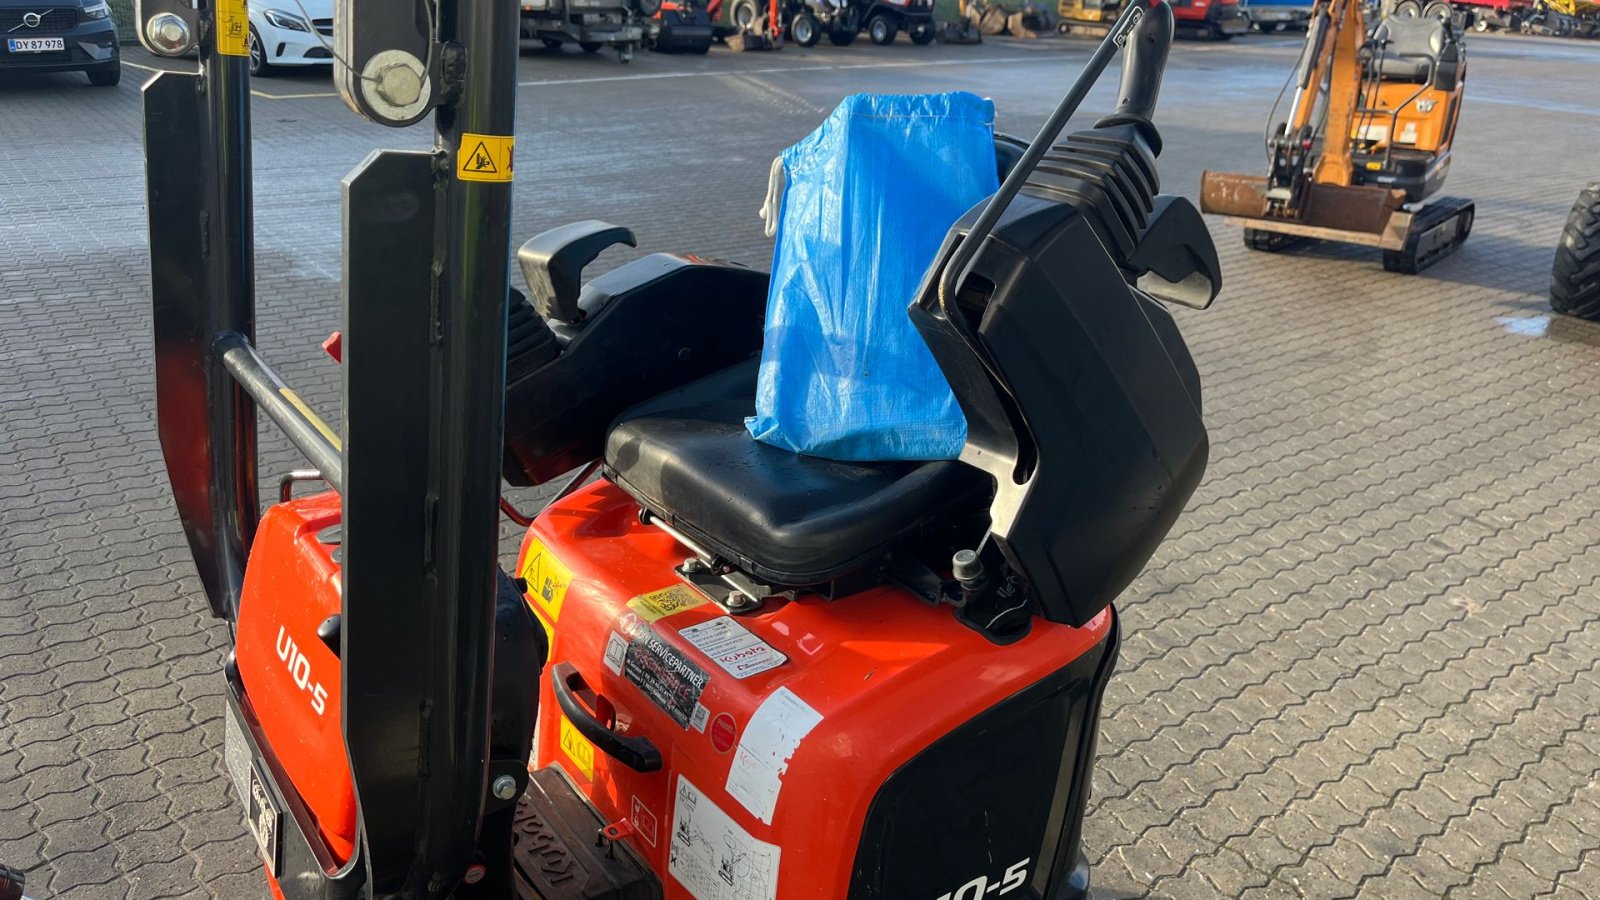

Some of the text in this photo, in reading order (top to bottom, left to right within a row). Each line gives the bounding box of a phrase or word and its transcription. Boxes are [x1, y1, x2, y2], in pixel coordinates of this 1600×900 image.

[16, 40, 63, 49] DY 87 978
[276, 625, 328, 716] U10-5
[647, 639, 704, 689] SERVICEPARTNER
[720, 646, 767, 663] Kubota
